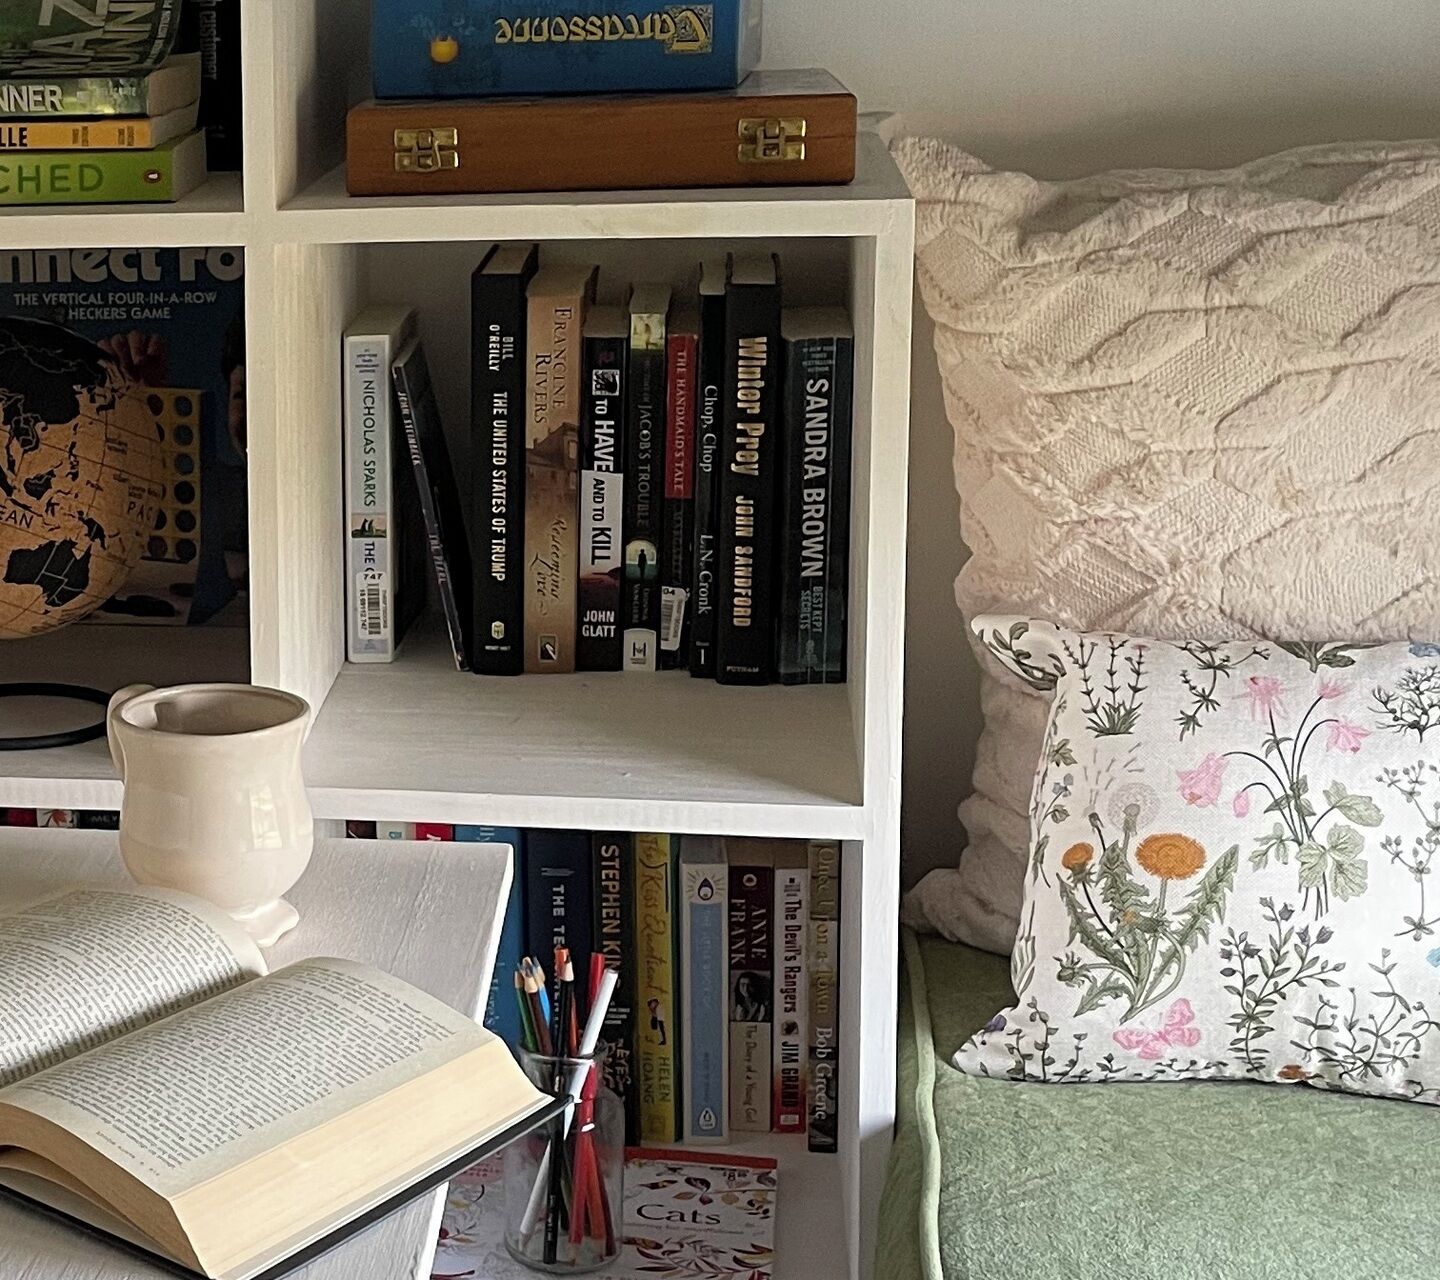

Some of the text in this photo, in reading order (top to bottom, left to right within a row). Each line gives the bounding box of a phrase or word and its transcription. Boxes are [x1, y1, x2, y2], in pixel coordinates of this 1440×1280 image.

[13, 290, 217, 306] THE VERTICAL FOUR-IN-A-ROW
[130, 307, 171, 320] GAME
[488, 323, 501, 372] O'REILLY
[502, 336, 514, 360] BILL
[551, 306, 573, 409] FRANCINE
[533, 352, 552, 424] RIVERS
[731, 337, 768, 476] Winter Prey
[363, 380, 377, 455] NICHOLAS
[397, 390, 421, 467] JOHN STEINBECK
[593, 398, 616, 472] TO HAVE
[636, 404, 653, 460] JACOB'S
[673, 349, 688, 492] THE HANDMAID'S TALE
[700, 385, 719, 473] Chop, Chop
[803, 378, 829, 480] SANDRA
[363, 460, 377, 508] SPARKS
[490, 391, 508, 581] THE UNITED STATES OF TRUMP
[636, 463, 651, 528] TROUBLE
[591, 477, 612, 566] AND TO KILL
[800, 487, 827, 578] BROWN
[364, 541, 375, 564] THE
[733, 495, 754, 627] JOHN SANDFORD
[582, 610, 615, 623] JOHN
[698, 570, 713, 615] Cronk
[800, 589, 812, 631] SECRETS
[810, 585, 824, 633] BEST KEPT
[582, 624, 616, 638] GLATT
[640, 872, 665, 910] Kiss
[817, 847, 834, 891] Once
[552, 884, 565, 917] THE
[601, 844, 621, 989] STEPHEN KIN
[812, 899, 835, 943] Upon
[730, 898, 746, 965] FRANK
[751, 903, 767, 959] ANNE
[781, 899, 802, 1013] The Devil's Rangers
[816, 967, 835, 1014] Town
[744, 1041, 757, 1062] Diary
[746, 1024, 758, 1039] The
[659, 1055, 671, 1101] HELEN
[743, 1082, 756, 1106] Young
[781, 1041, 800, 1108] JIM GRAND
[813, 1026, 833, 1120] Bob Greene
[746, 1108, 758, 1124] Girl
[636, 1203, 721, 1225] Cats
